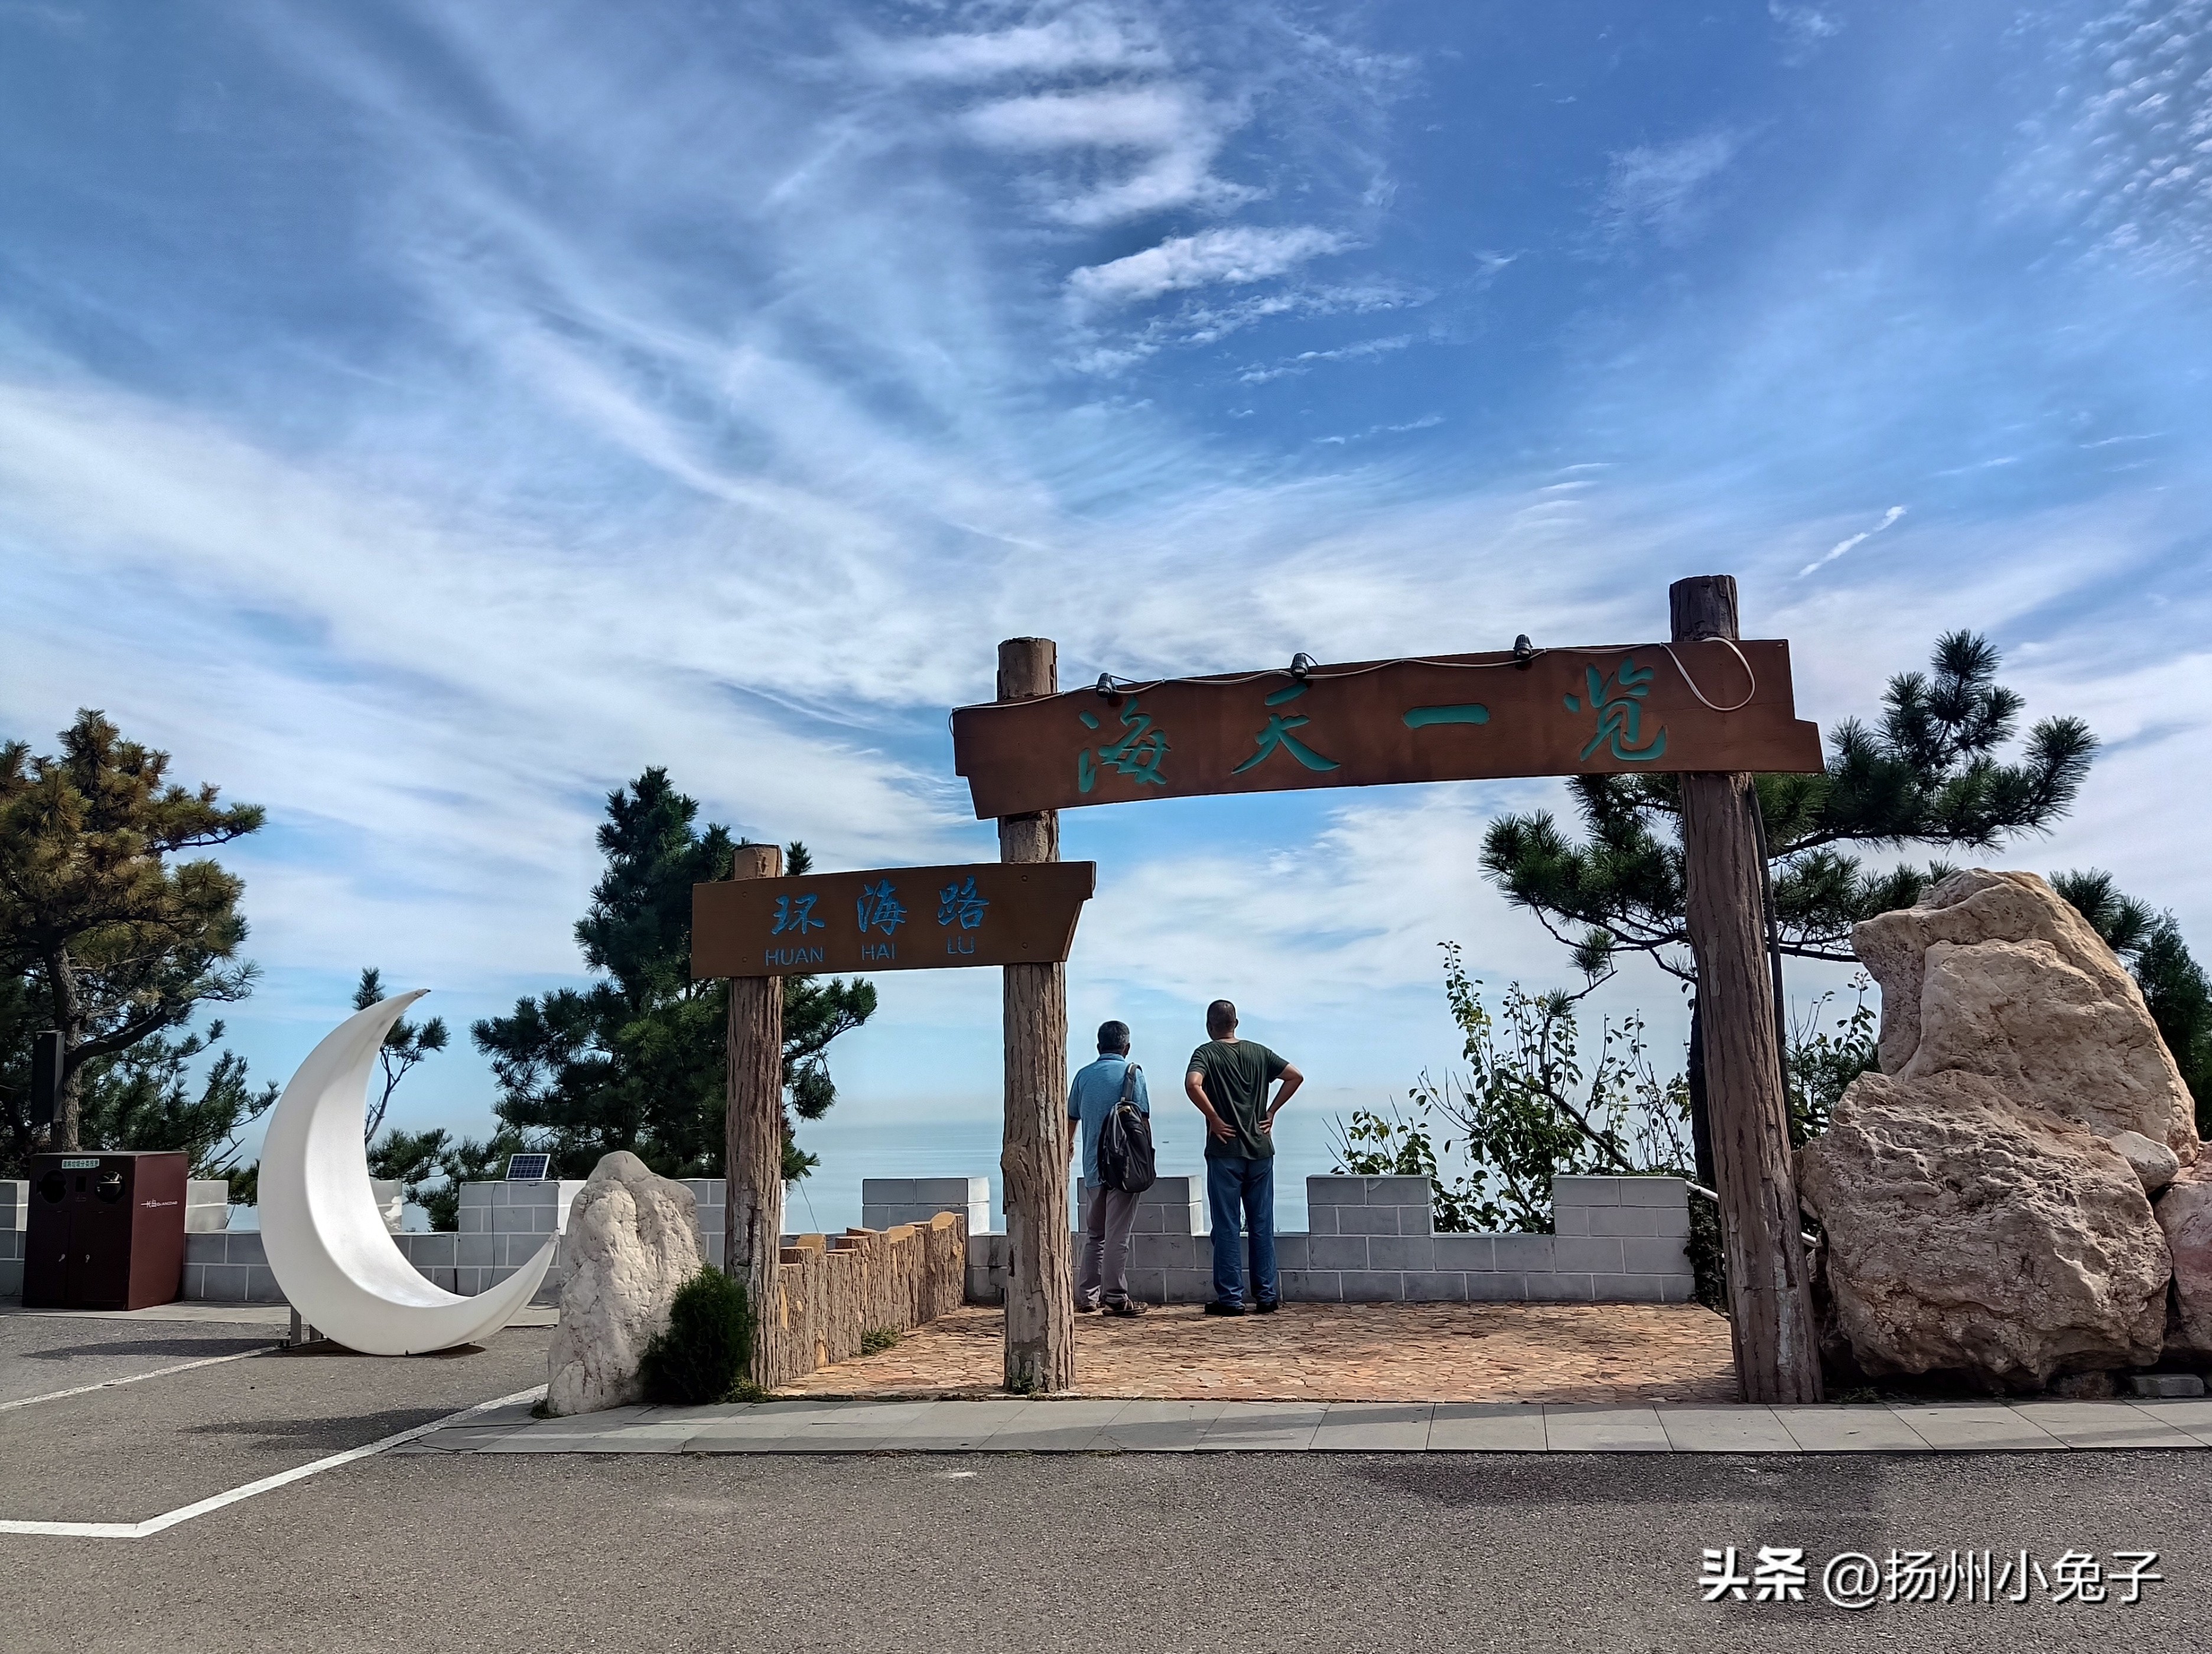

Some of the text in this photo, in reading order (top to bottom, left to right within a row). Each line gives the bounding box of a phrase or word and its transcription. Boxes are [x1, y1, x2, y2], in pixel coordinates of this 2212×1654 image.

[1078, 657, 1667, 795] 海天一览
[770, 875, 990, 936] 环海路
[765, 937, 975, 966] HUAN HAI LU
